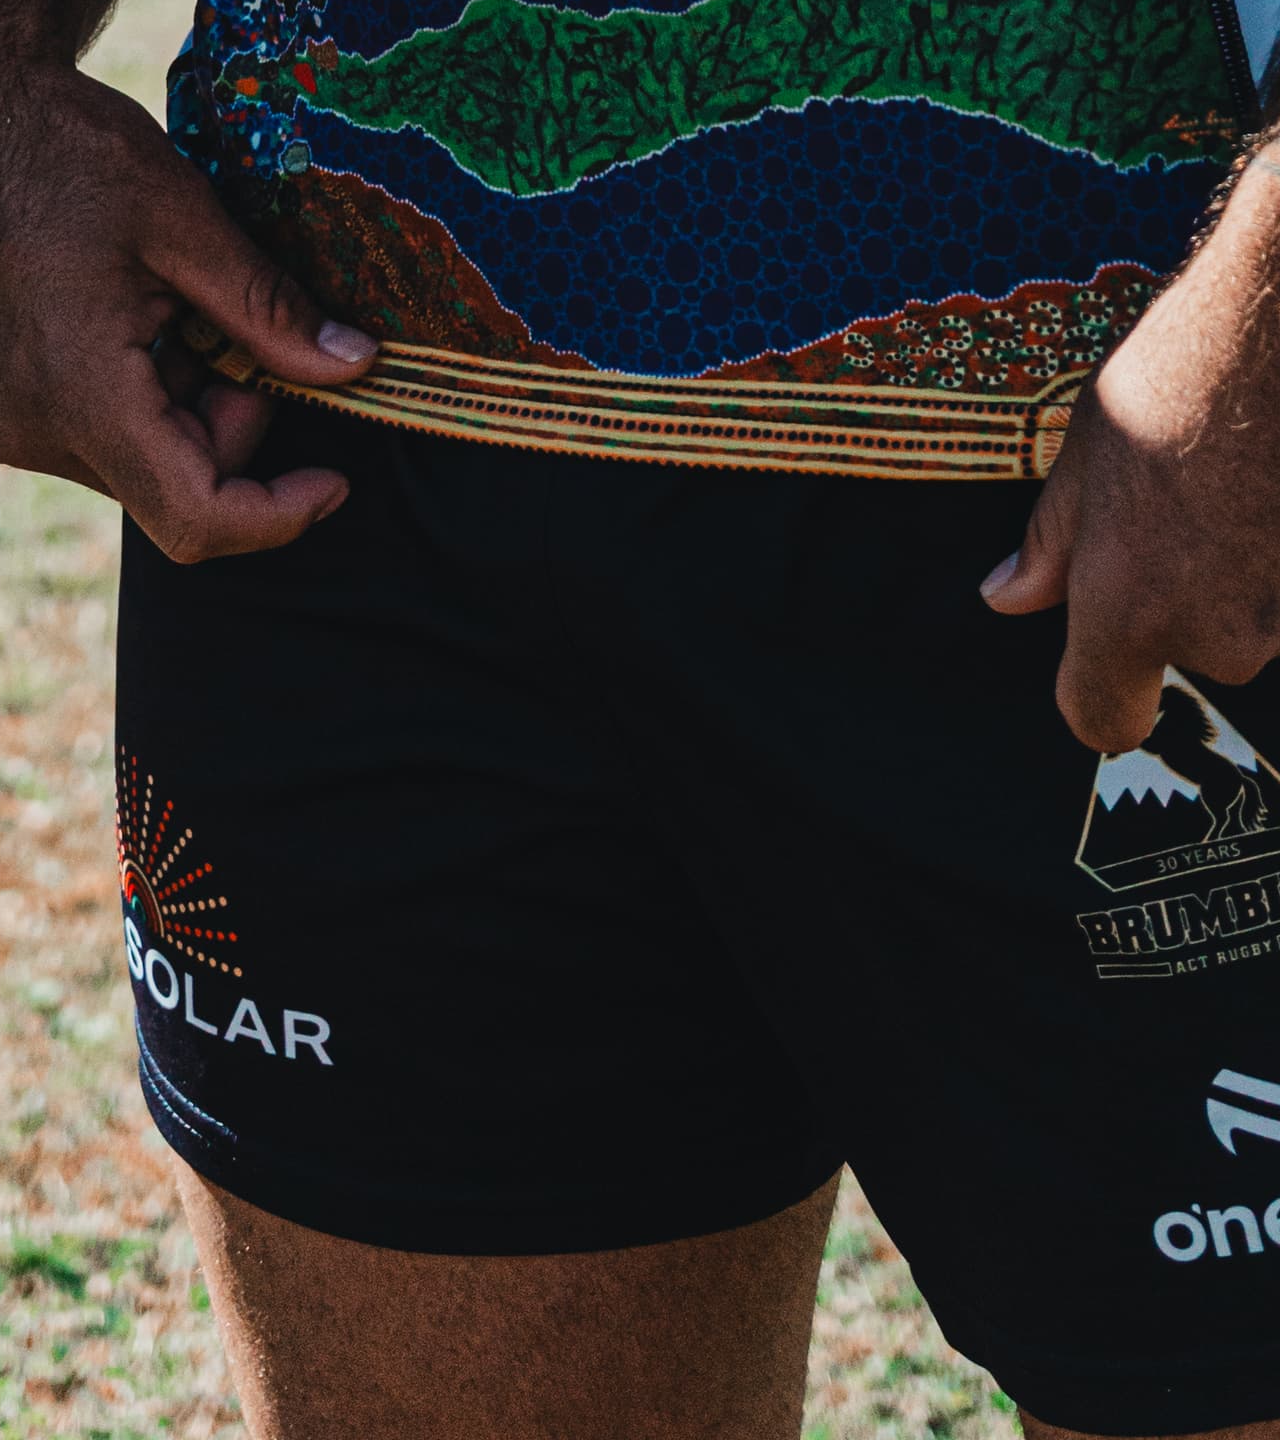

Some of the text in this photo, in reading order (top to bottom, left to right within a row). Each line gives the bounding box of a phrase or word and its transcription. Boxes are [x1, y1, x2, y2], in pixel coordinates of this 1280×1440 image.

[1155, 842, 1241, 873] 30 YEARS
[1176, 940, 1272, 974] ACT RUGBY
[124, 916, 334, 1066] SOLAR
